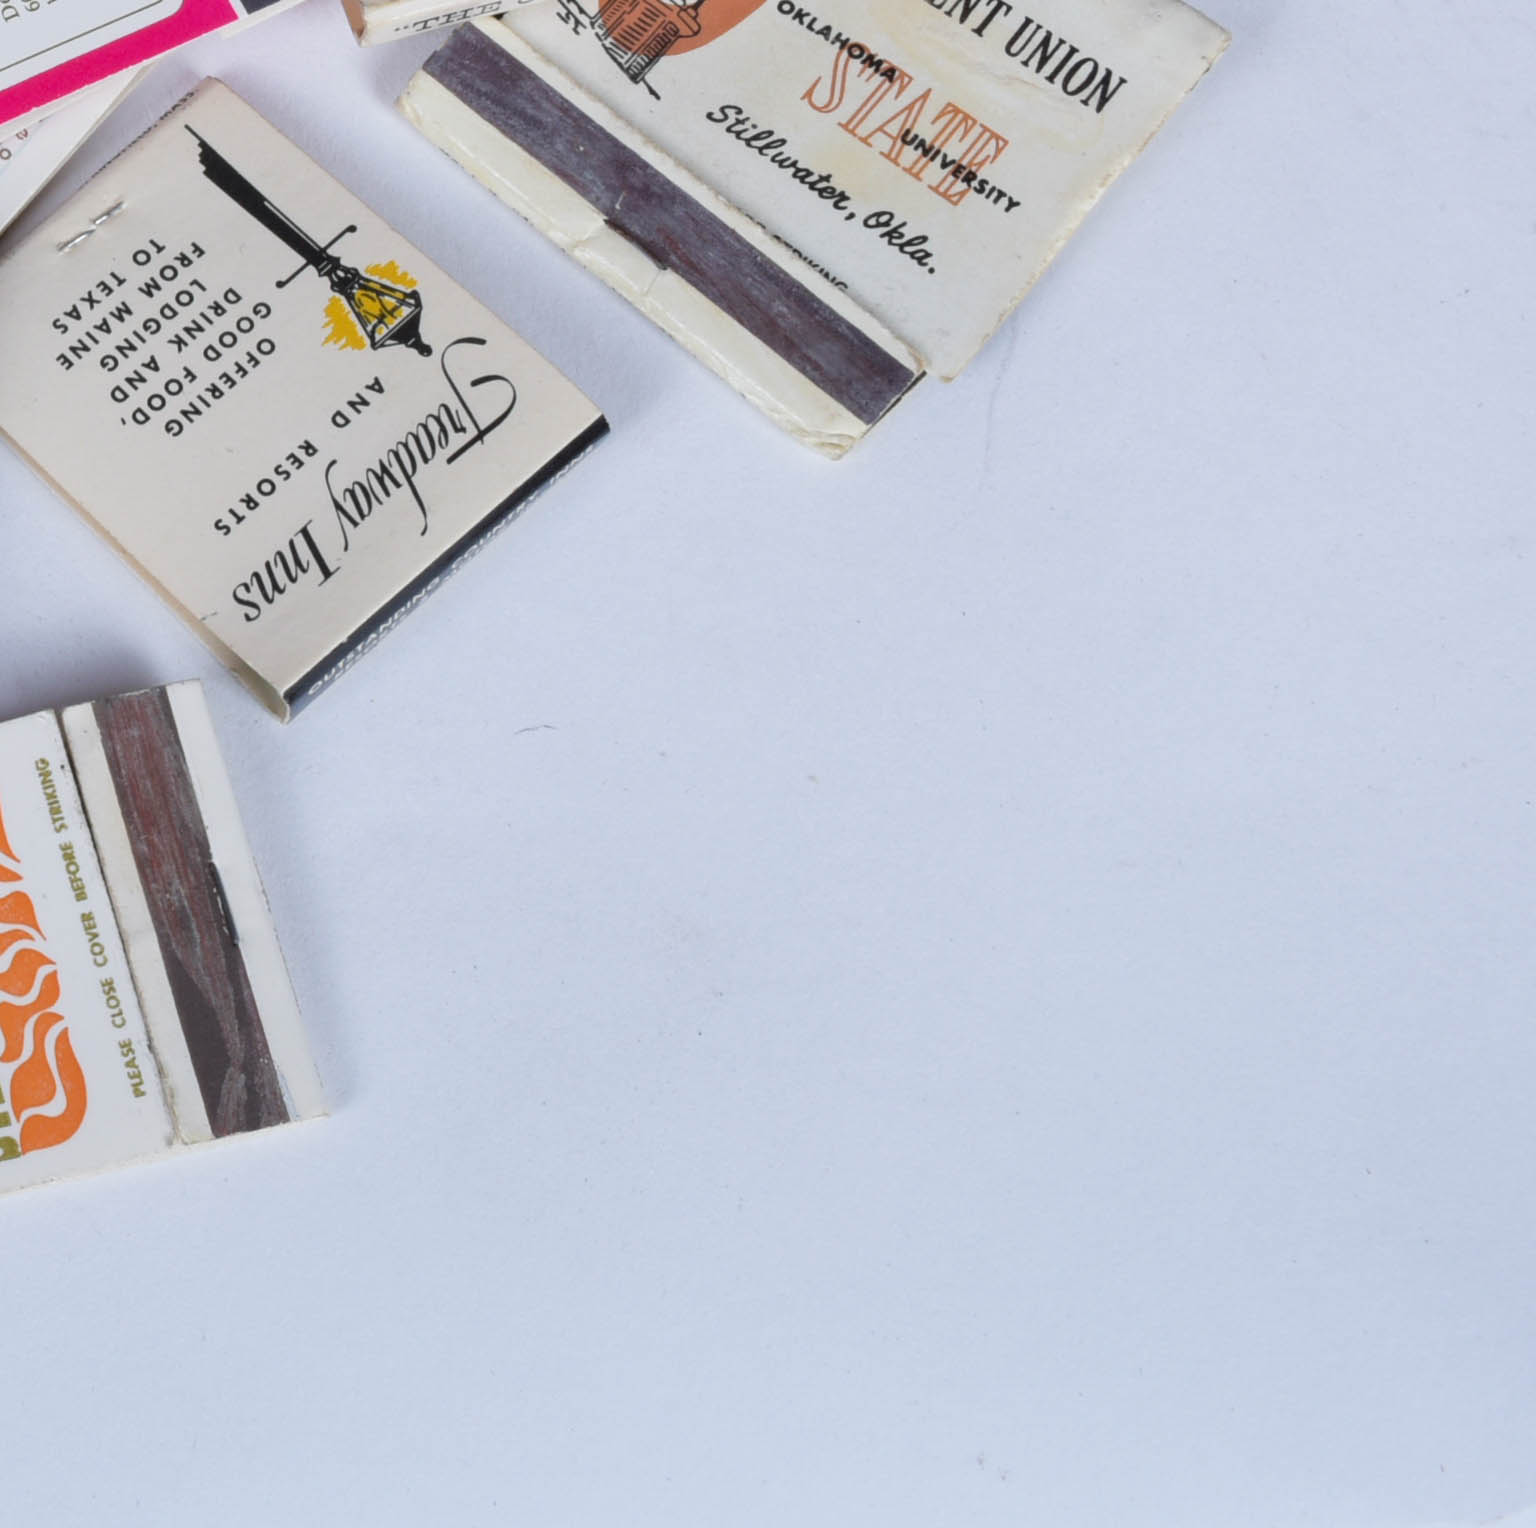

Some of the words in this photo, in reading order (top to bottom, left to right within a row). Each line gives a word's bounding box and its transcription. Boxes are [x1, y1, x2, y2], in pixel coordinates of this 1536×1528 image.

[776, 0, 899, 84] OKLAHOMA
[1004, 16, 1128, 114] UNION
[800, 41, 1010, 207] STATE
[707, 104, 856, 222] Stillwater,
[862, 209, 936, 275] Okla.
[899, 127, 1021, 214] UNIVERSITY
[131, 239, 166, 268] TO
[154, 240, 206, 295] FROM
[52, 273, 126, 335] TEXAS
[56, 295, 135, 371] MAINE
[99, 279, 208, 373] LODGING
[167, 288, 242, 354] DRINK
[201, 301, 272, 362] GOOD
[110, 355, 160, 403] AND
[164, 337, 276, 438] OFFERING
[330, 377, 386, 429] AND
[324, 336, 518, 552] Treadway
[213, 439, 319, 537] RESORTS
[231, 519, 341, 623] Inns
[35, 757, 68, 834] STRIKING
[58, 839, 89, 903] BEFORE
[99, 977, 127, 1030] CLOSE
